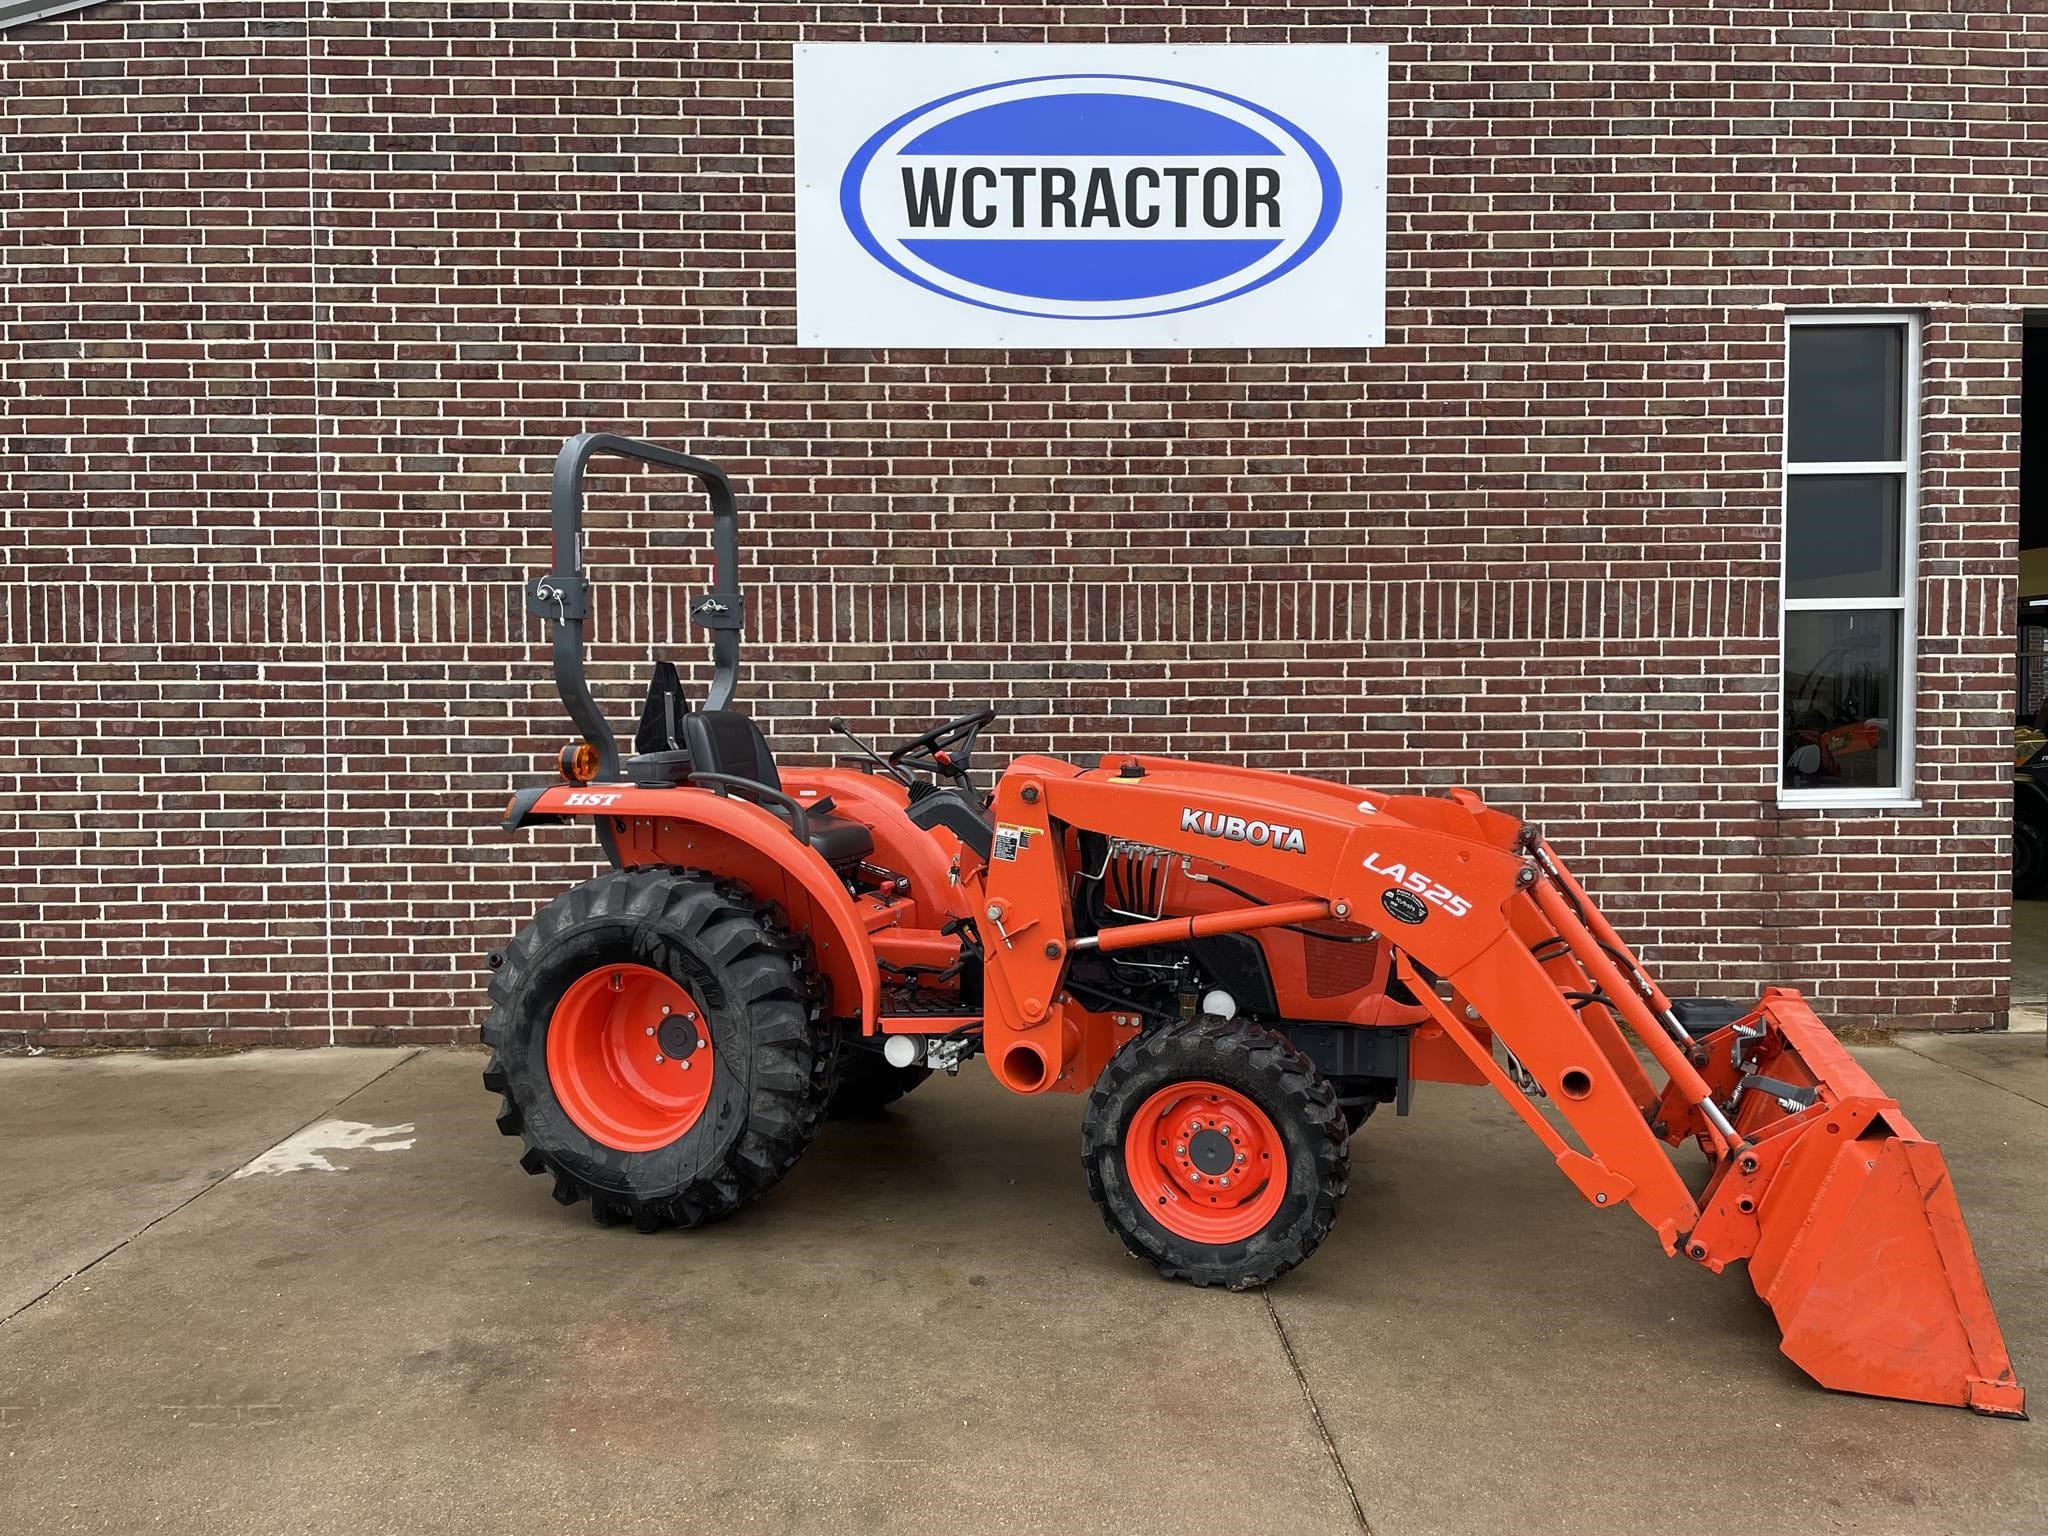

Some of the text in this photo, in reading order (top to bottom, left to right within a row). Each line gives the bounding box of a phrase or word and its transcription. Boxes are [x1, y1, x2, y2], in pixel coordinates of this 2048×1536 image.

[901, 166, 1281, 228] WCTRACTOR
[563, 793, 622, 806] HST
[1180, 807, 1306, 854] KUBOTA
[1363, 852, 1472, 917] LA525
